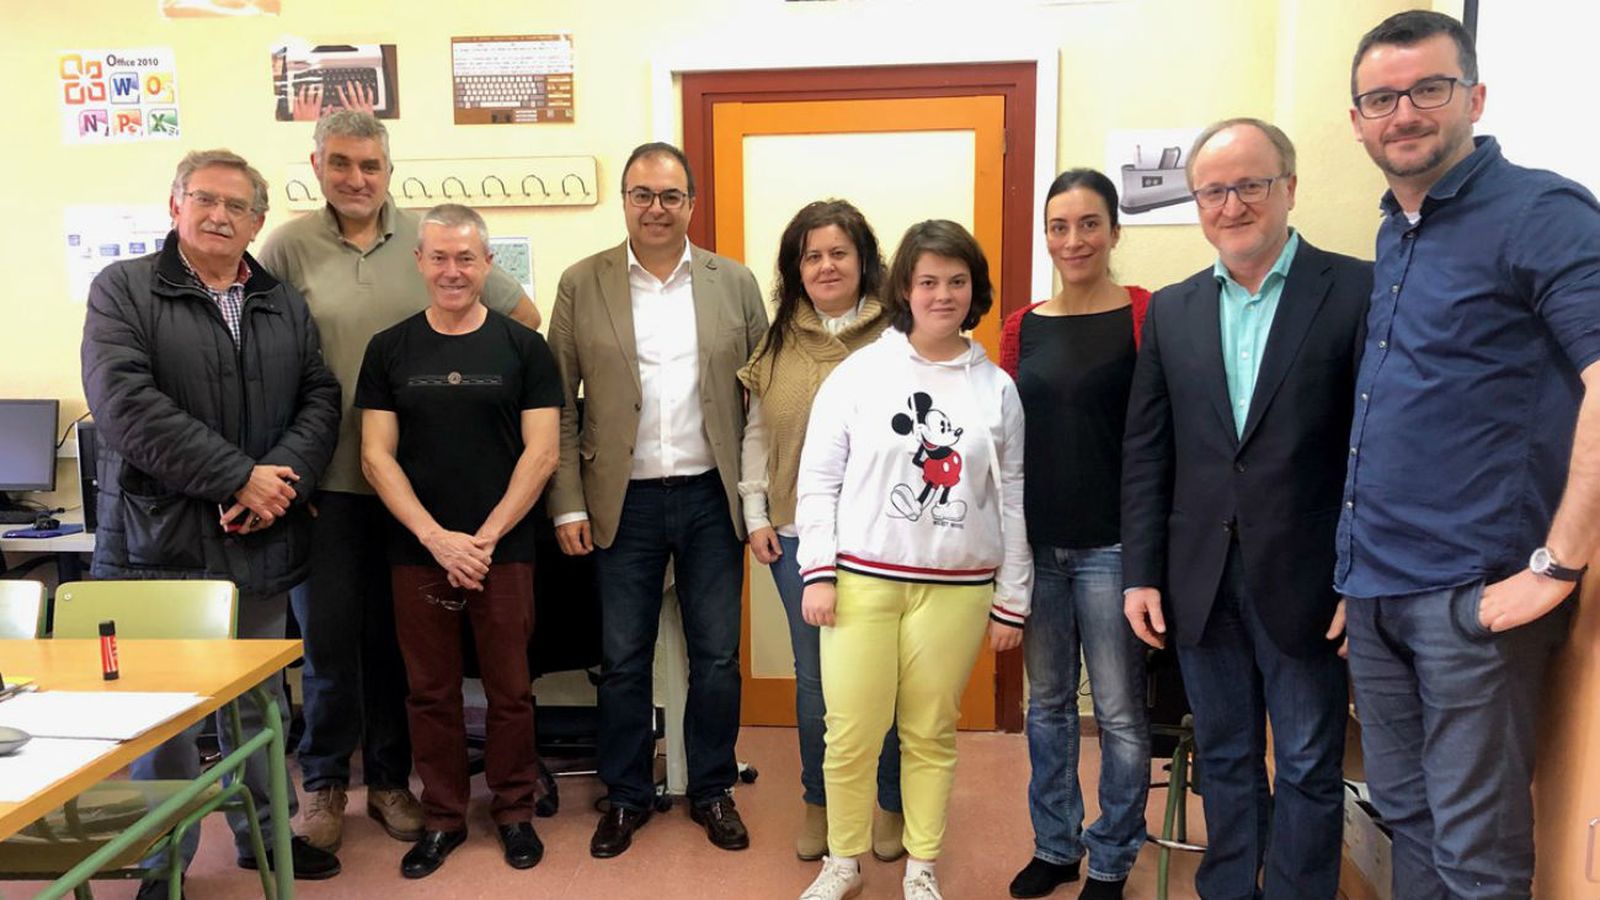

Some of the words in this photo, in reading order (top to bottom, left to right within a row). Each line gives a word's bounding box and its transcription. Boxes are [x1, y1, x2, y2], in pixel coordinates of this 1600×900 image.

[106, 54, 135, 67] Office
[138, 58, 159, 67] 2010
[113, 78, 131, 96] W
[83, 114, 98, 132] N
[151, 113, 167, 132] X
